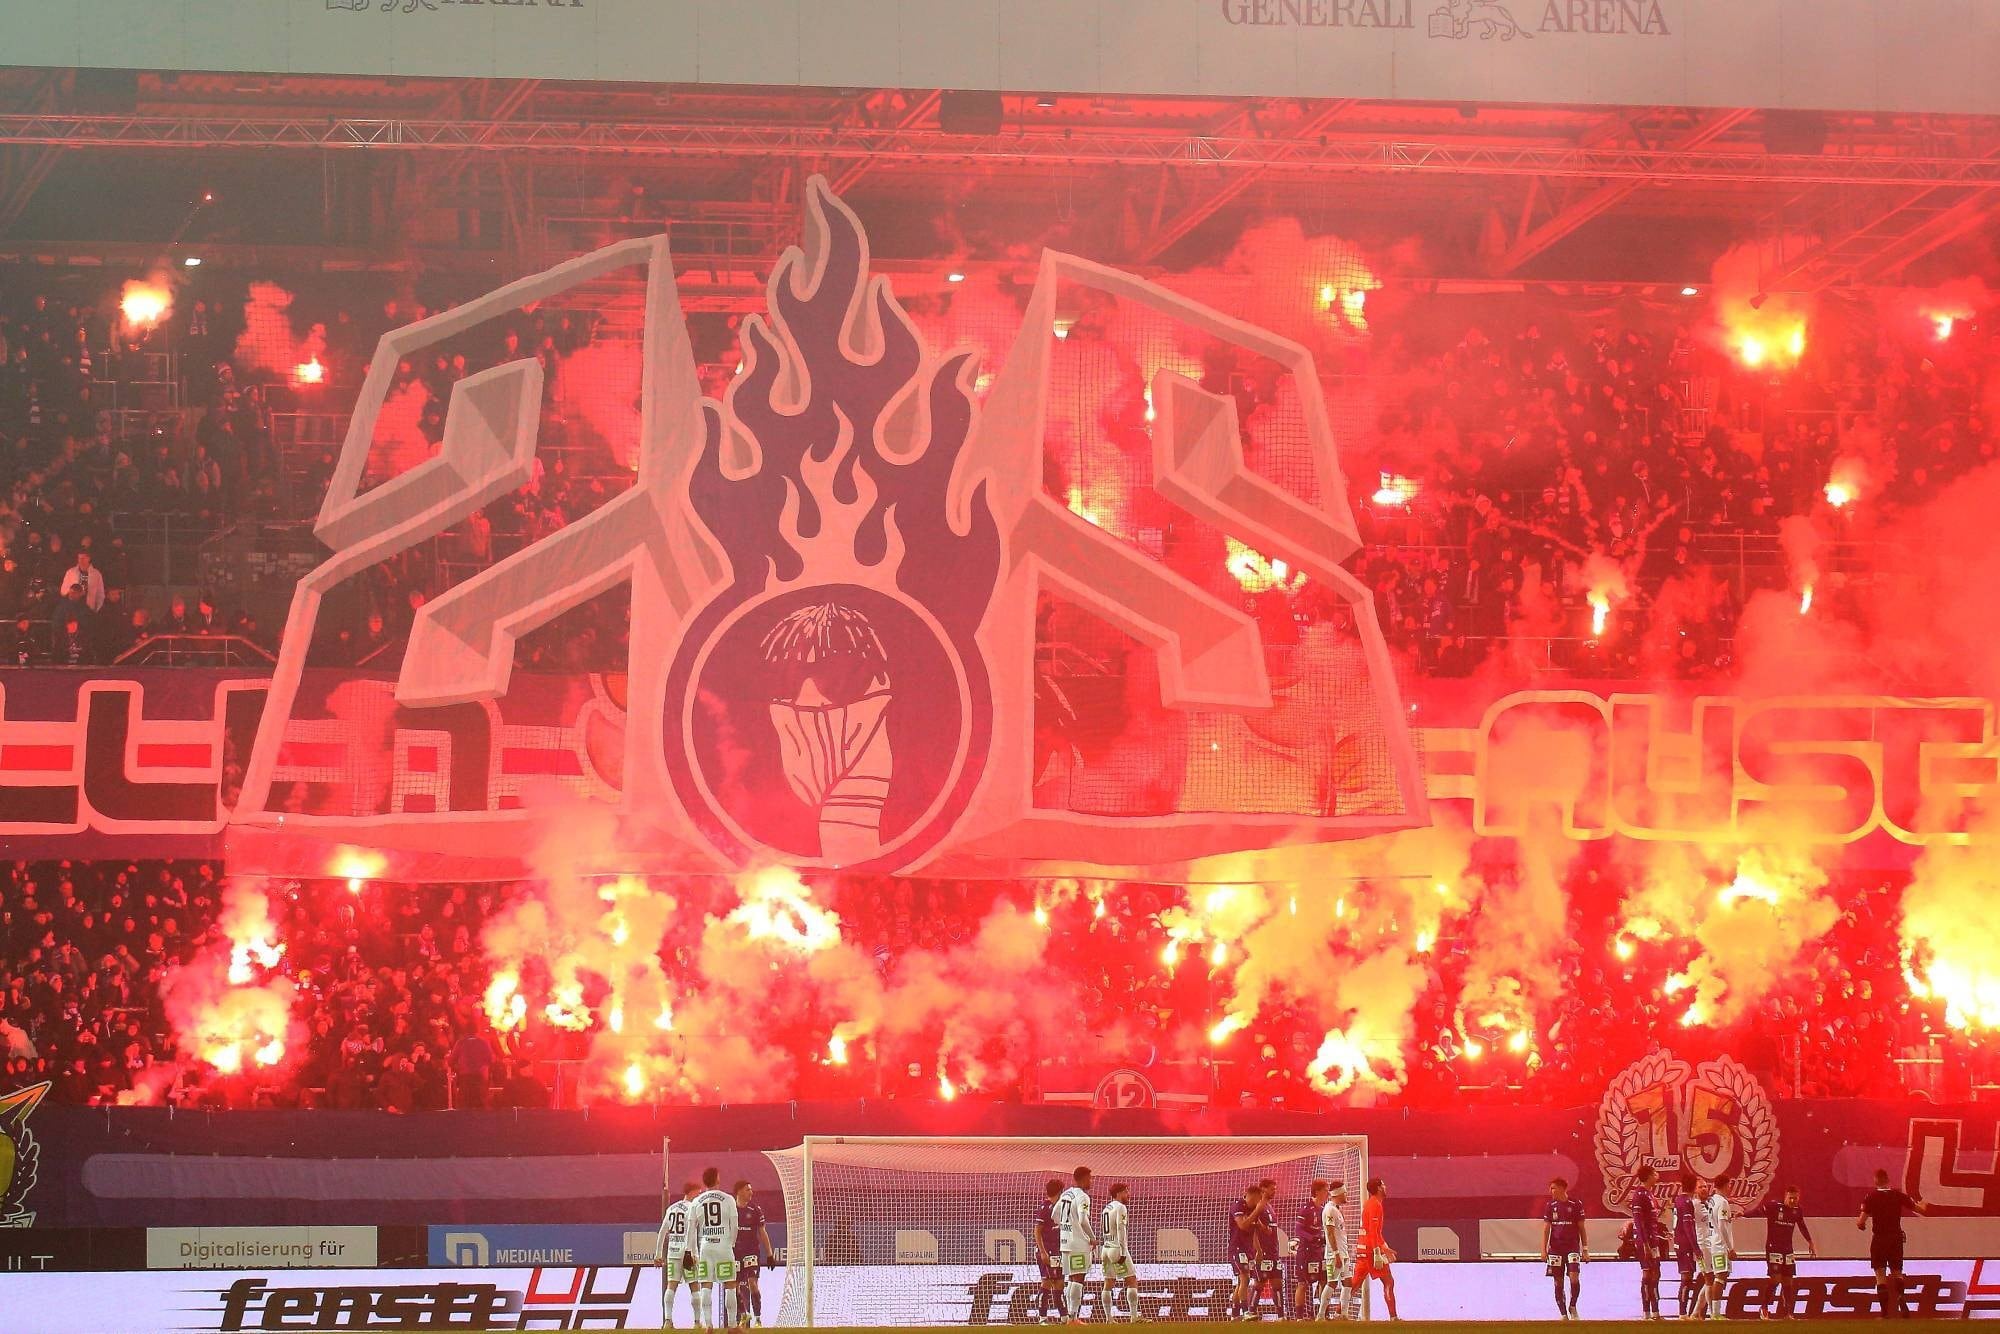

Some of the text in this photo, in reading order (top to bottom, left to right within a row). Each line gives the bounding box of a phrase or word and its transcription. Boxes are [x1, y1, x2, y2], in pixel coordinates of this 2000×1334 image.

[1222, 0, 1671, 35] GENERALI ARENA
[1625, 1083, 1743, 1179] 15
[668, 1212, 685, 1234] 26
[702, 1201, 722, 1227] 19
[180, 1240, 345, 1260] Digitalisierung für
[496, 1248, 573, 1263] MEDIALINE
[1421, 1248, 1457, 1256] MEDIALINE
